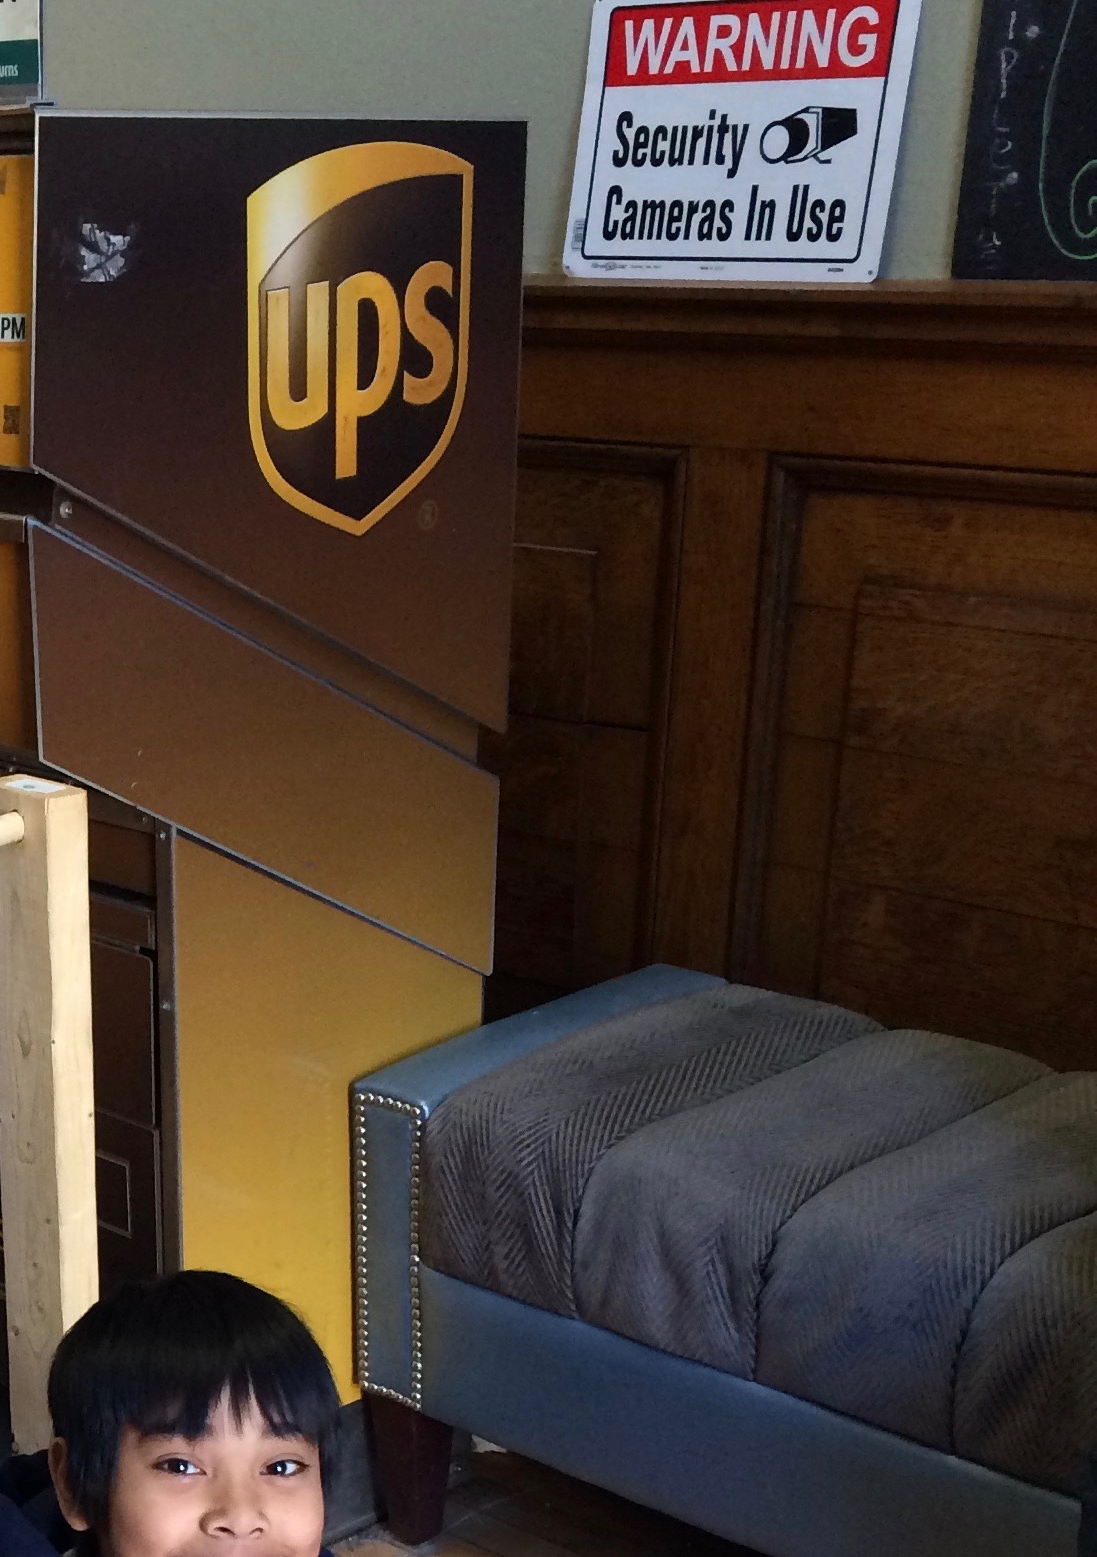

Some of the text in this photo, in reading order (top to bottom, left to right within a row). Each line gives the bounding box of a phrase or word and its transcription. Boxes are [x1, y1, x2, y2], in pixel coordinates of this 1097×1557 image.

[624, 6, 880, 76] WARNING
[612, 109, 750, 179] Security
[602, 184, 735, 242] Cameras
[744, 184, 777, 242] In
[786, 183, 847, 242] Use
[0, 316, 26, 340] PM
